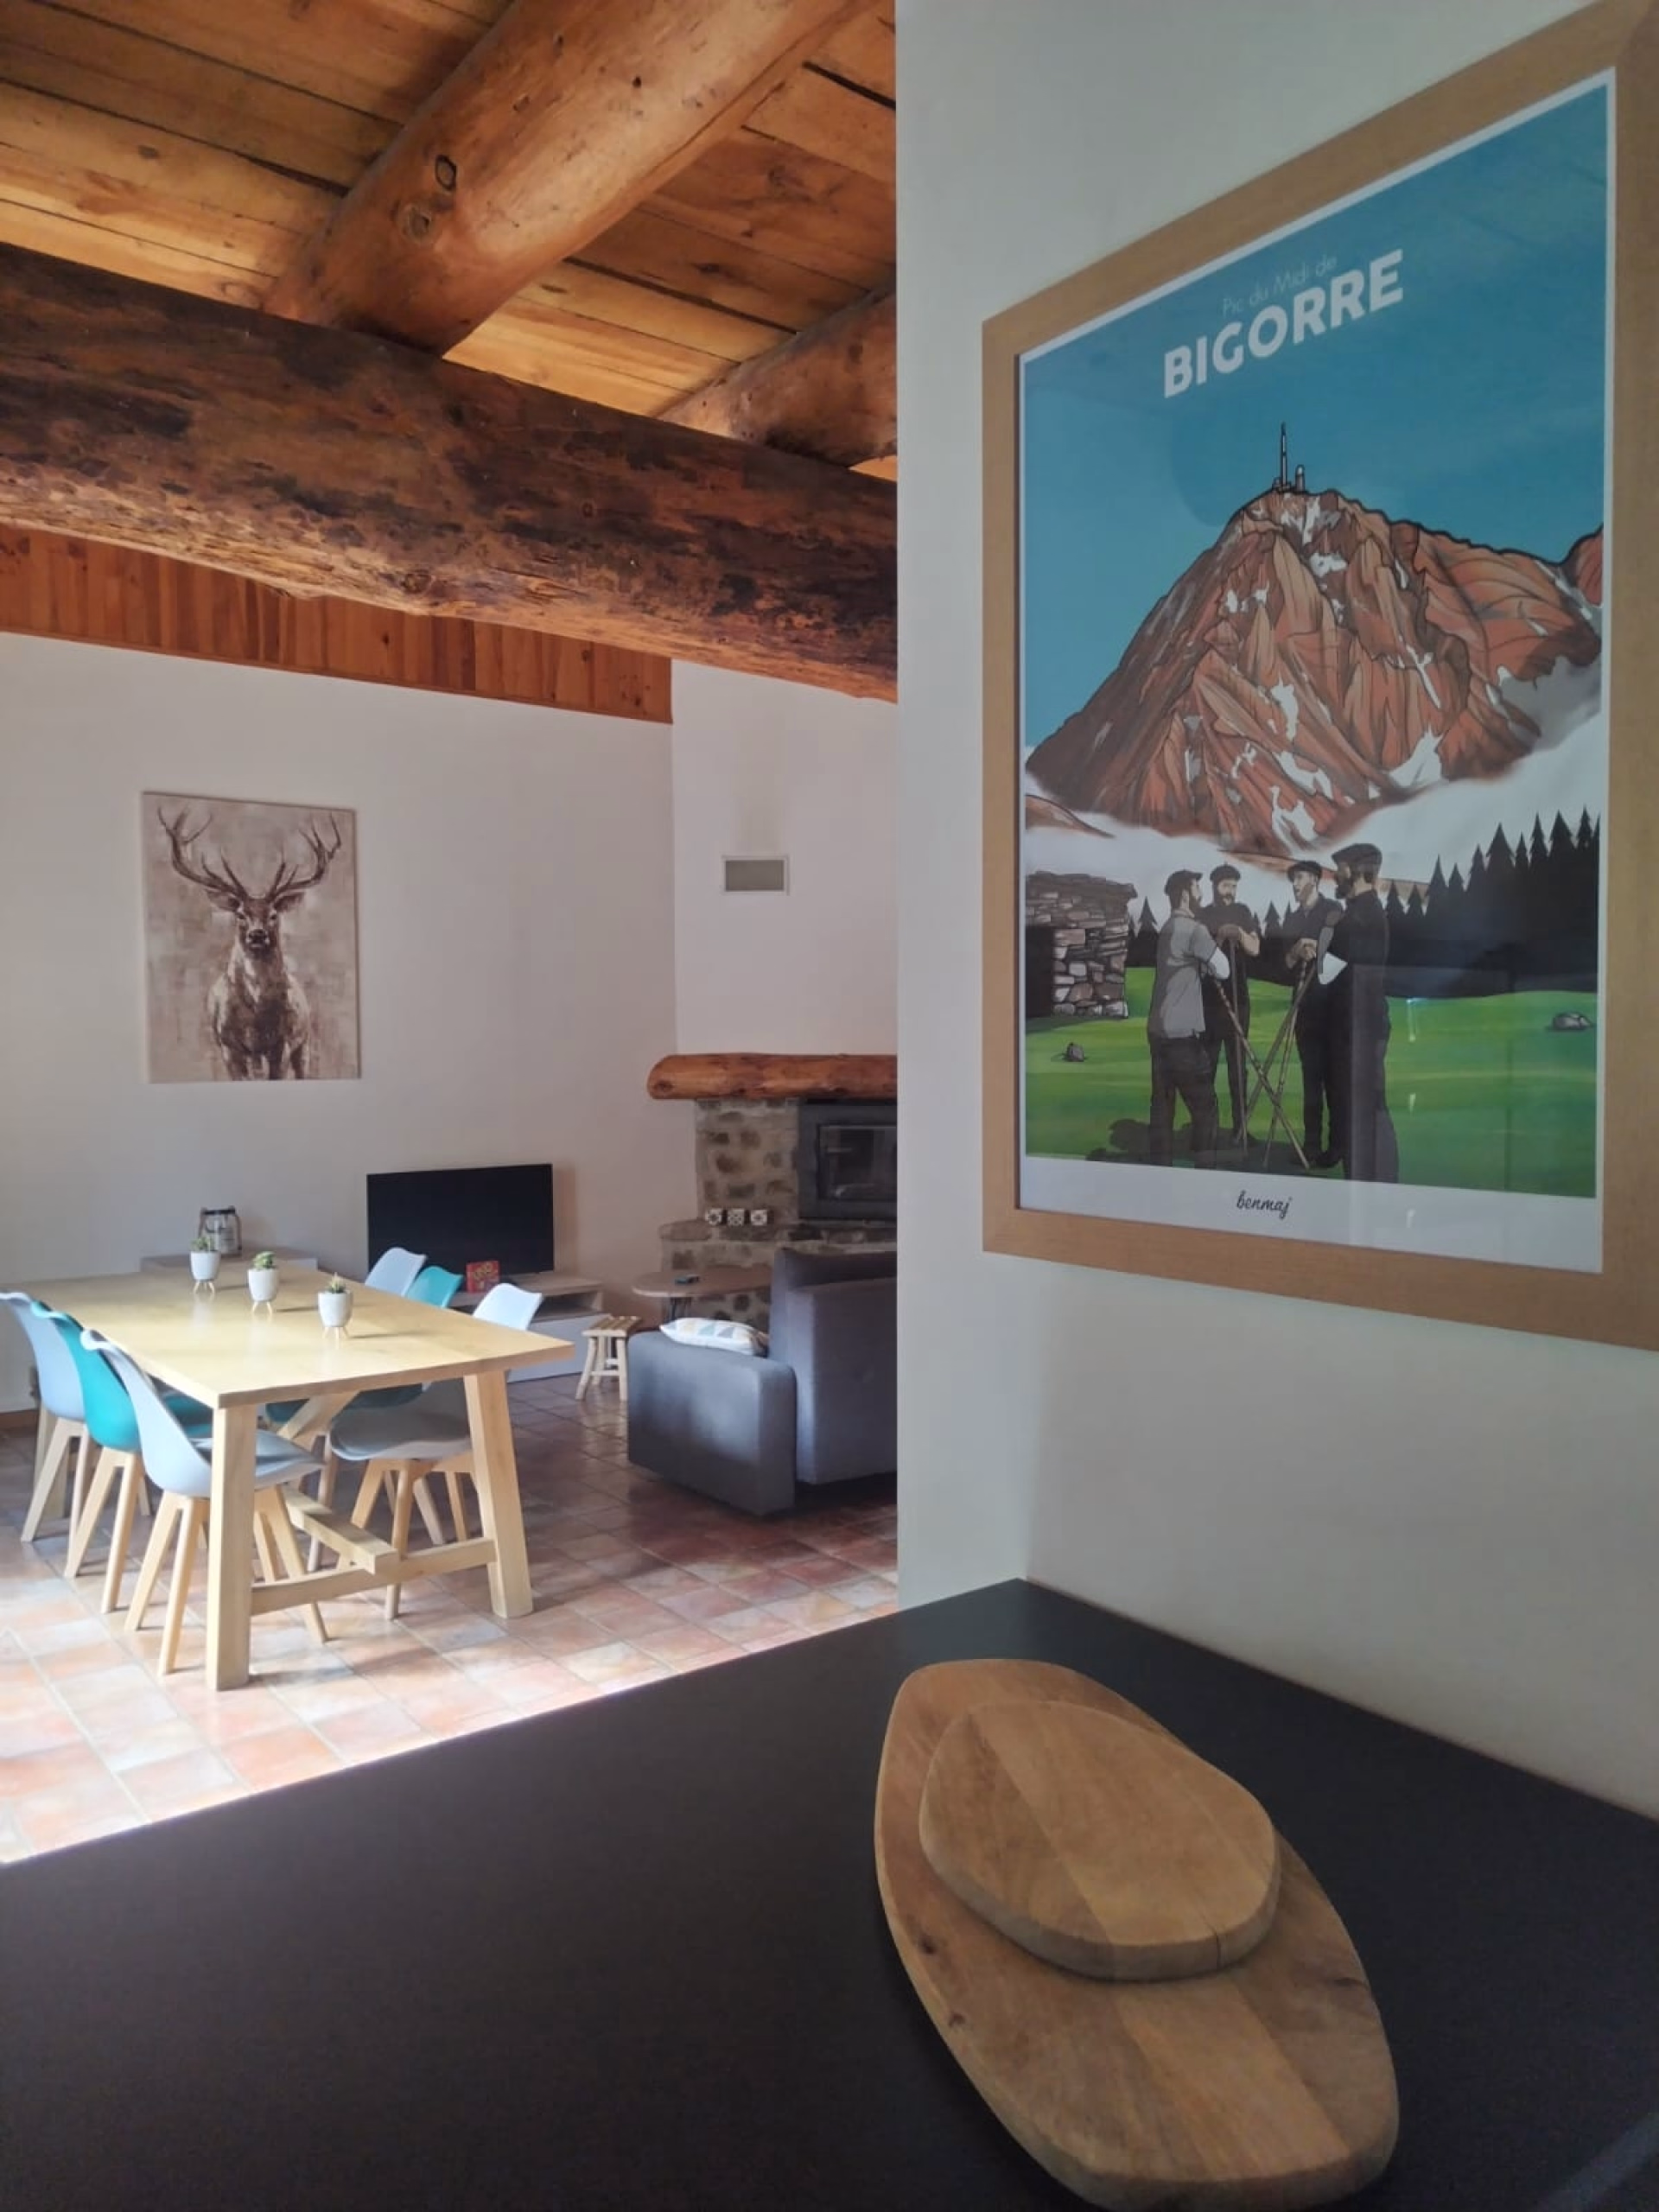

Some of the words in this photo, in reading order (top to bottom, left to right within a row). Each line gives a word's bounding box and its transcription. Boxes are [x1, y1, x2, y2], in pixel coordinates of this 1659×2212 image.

[1249, 280, 1269, 307] du
[1315, 253, 1338, 277] de
[1164, 249, 1404, 398] BIGORRE
[1236, 1190, 1293, 1220] benmaj
